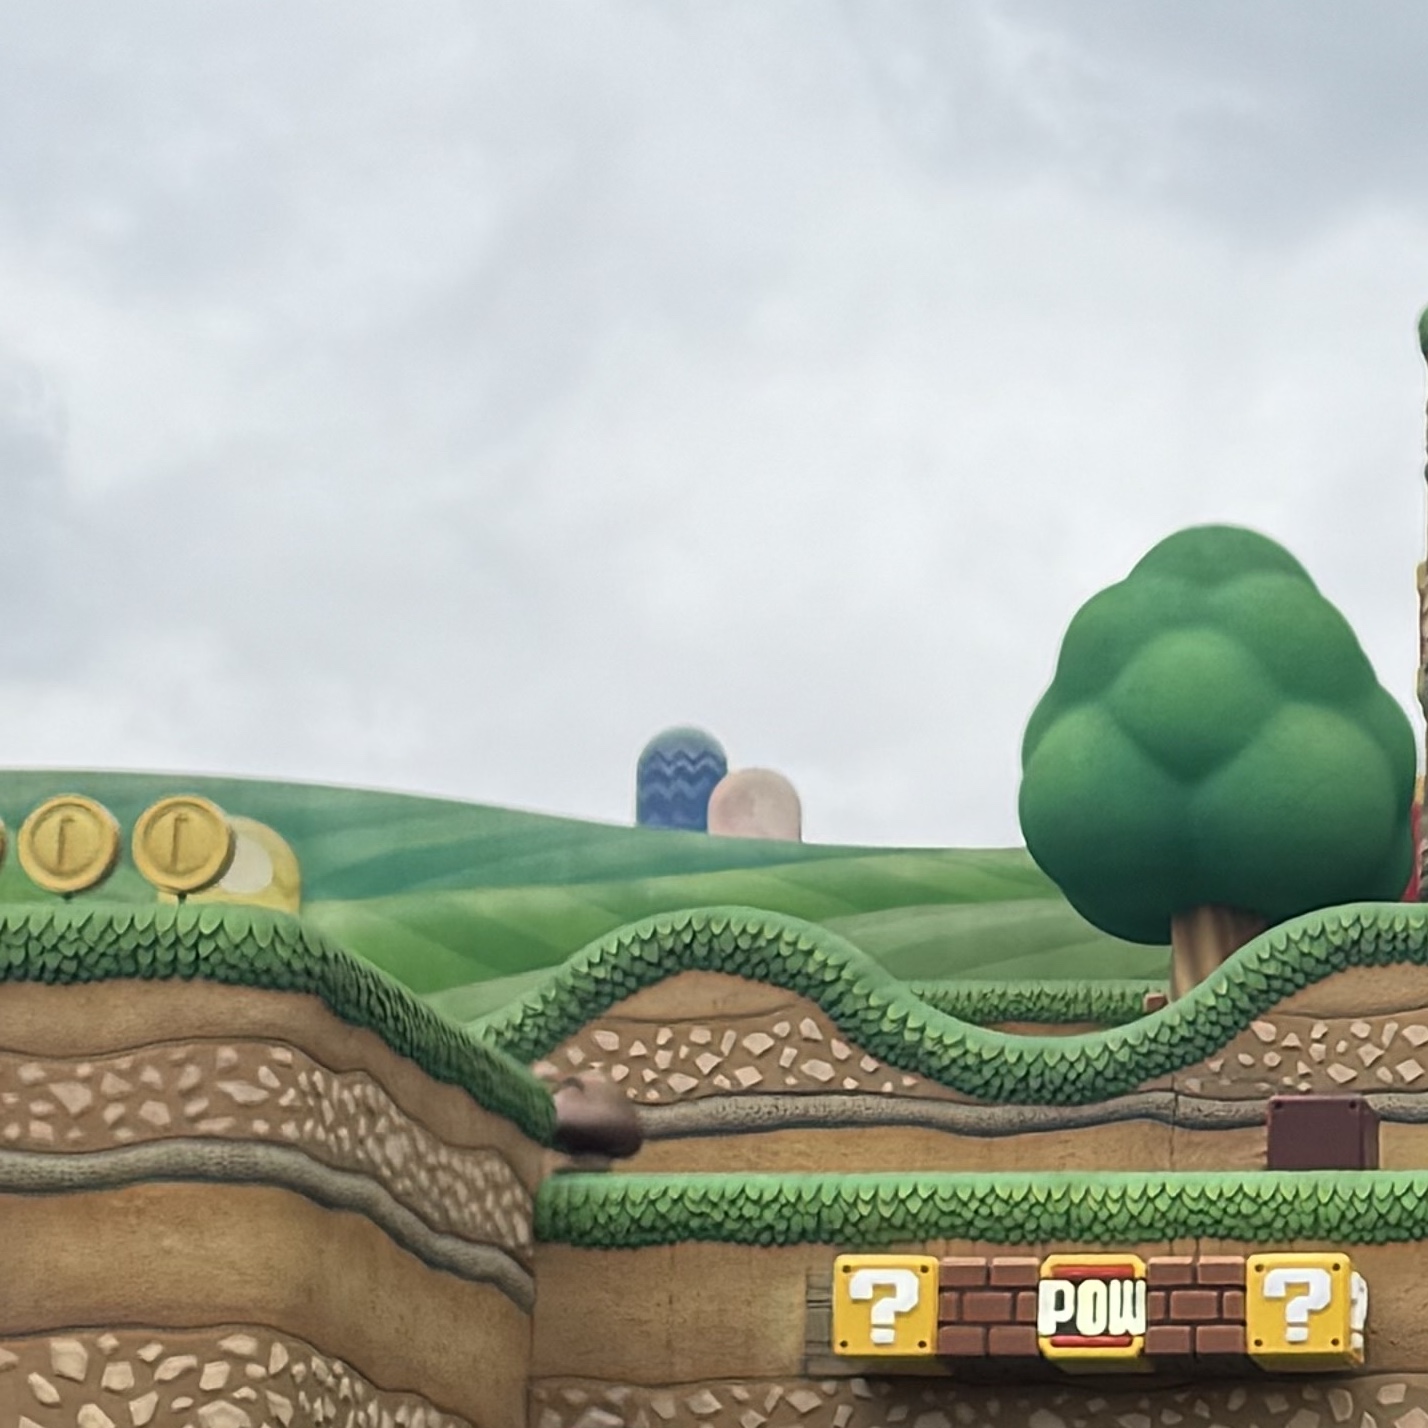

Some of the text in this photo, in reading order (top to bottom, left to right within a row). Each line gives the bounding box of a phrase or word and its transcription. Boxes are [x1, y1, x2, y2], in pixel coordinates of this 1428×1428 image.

[849, 1268, 920, 1345] ?
[1037, 1279, 1147, 1337] POW
[1262, 1267, 1332, 1344] ?
